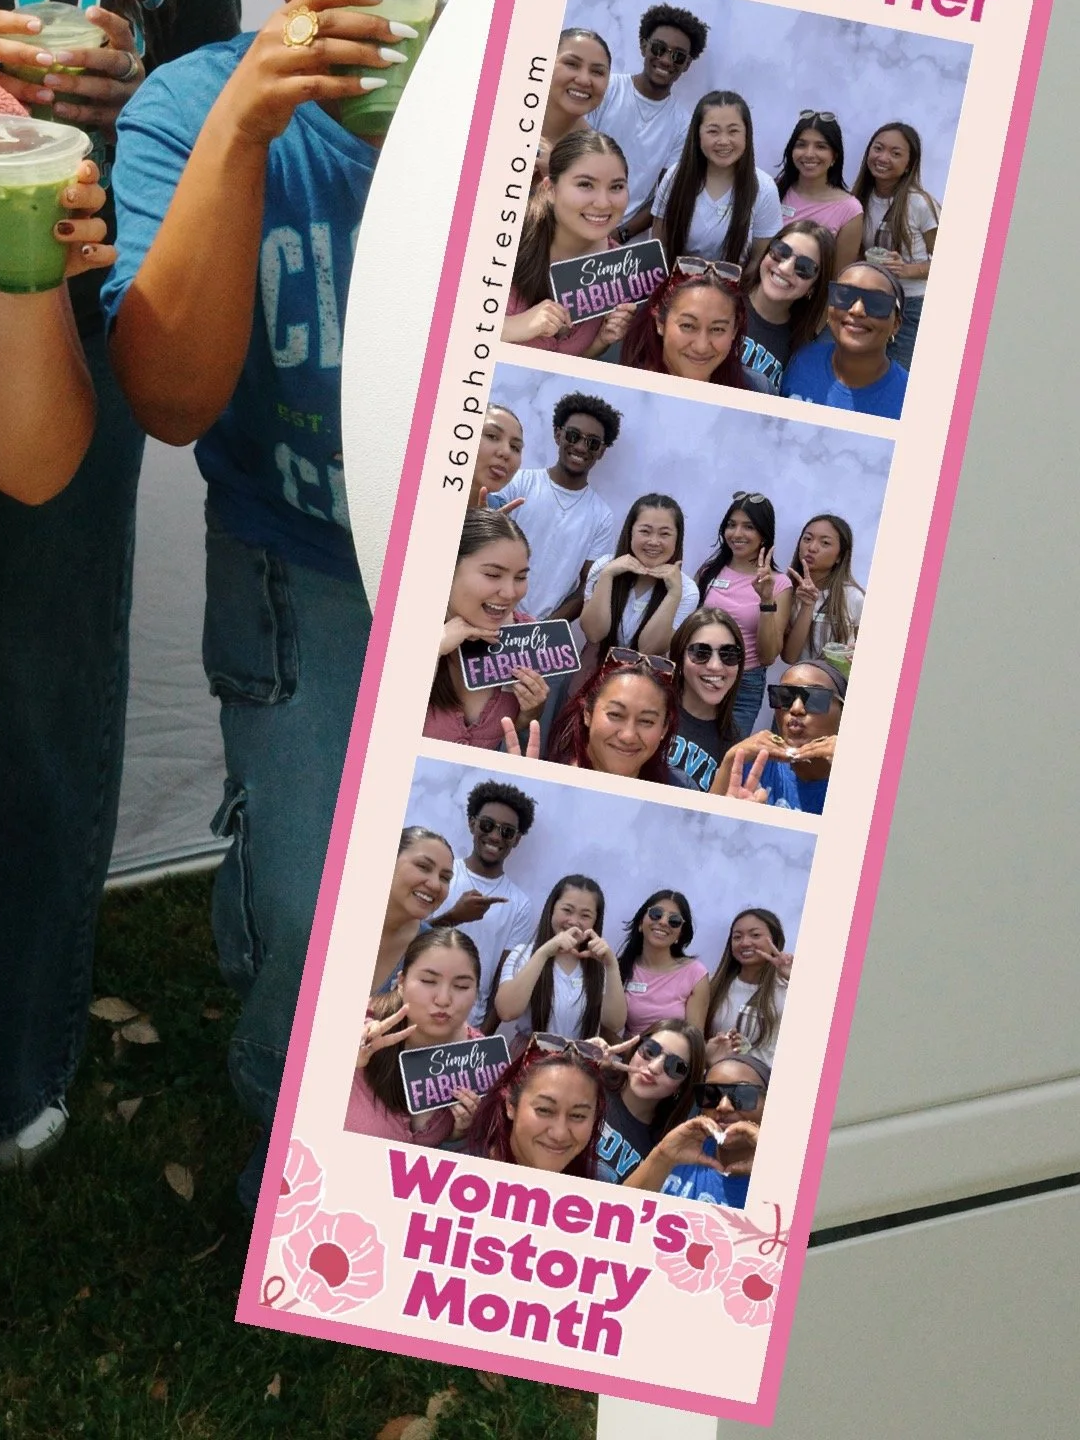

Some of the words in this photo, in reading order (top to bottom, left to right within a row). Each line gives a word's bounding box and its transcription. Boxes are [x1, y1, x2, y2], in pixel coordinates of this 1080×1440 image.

[580, 249, 641, 286] Simply
[561, 266, 665, 317] FABULOUS
[487, 625, 550, 655] Simply
[467, 644, 576, 685] FABULOUS
[429, 1042, 488, 1076] Simply
